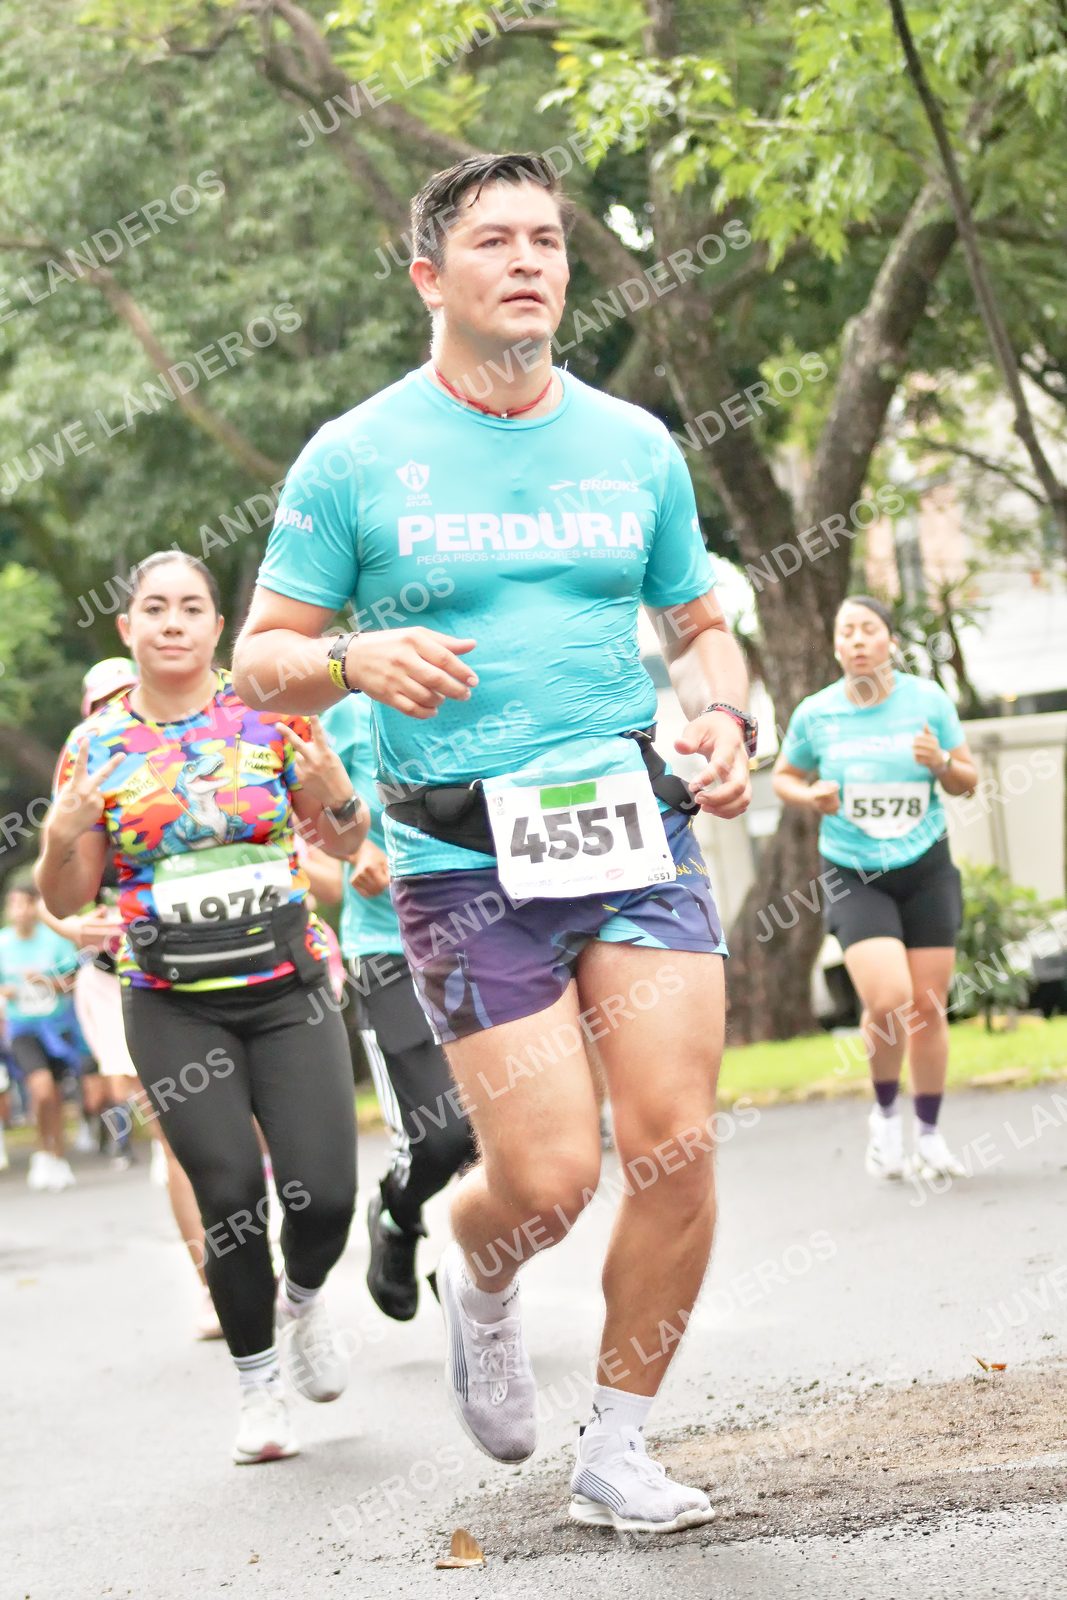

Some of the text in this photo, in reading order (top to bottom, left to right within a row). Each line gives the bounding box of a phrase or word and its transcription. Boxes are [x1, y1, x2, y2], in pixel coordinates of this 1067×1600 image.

[579, 479, 640, 493] BROOKS
[275, 505, 314, 534] URA
[397, 511, 644, 557] PERDURA
[416, 548, 637, 566] PEGA PISOS JUNTEADORES ESTUCOS
[852, 797, 922, 818] 5578
[510, 802, 644, 864] 4551
[647, 871, 671, 882] 4551
